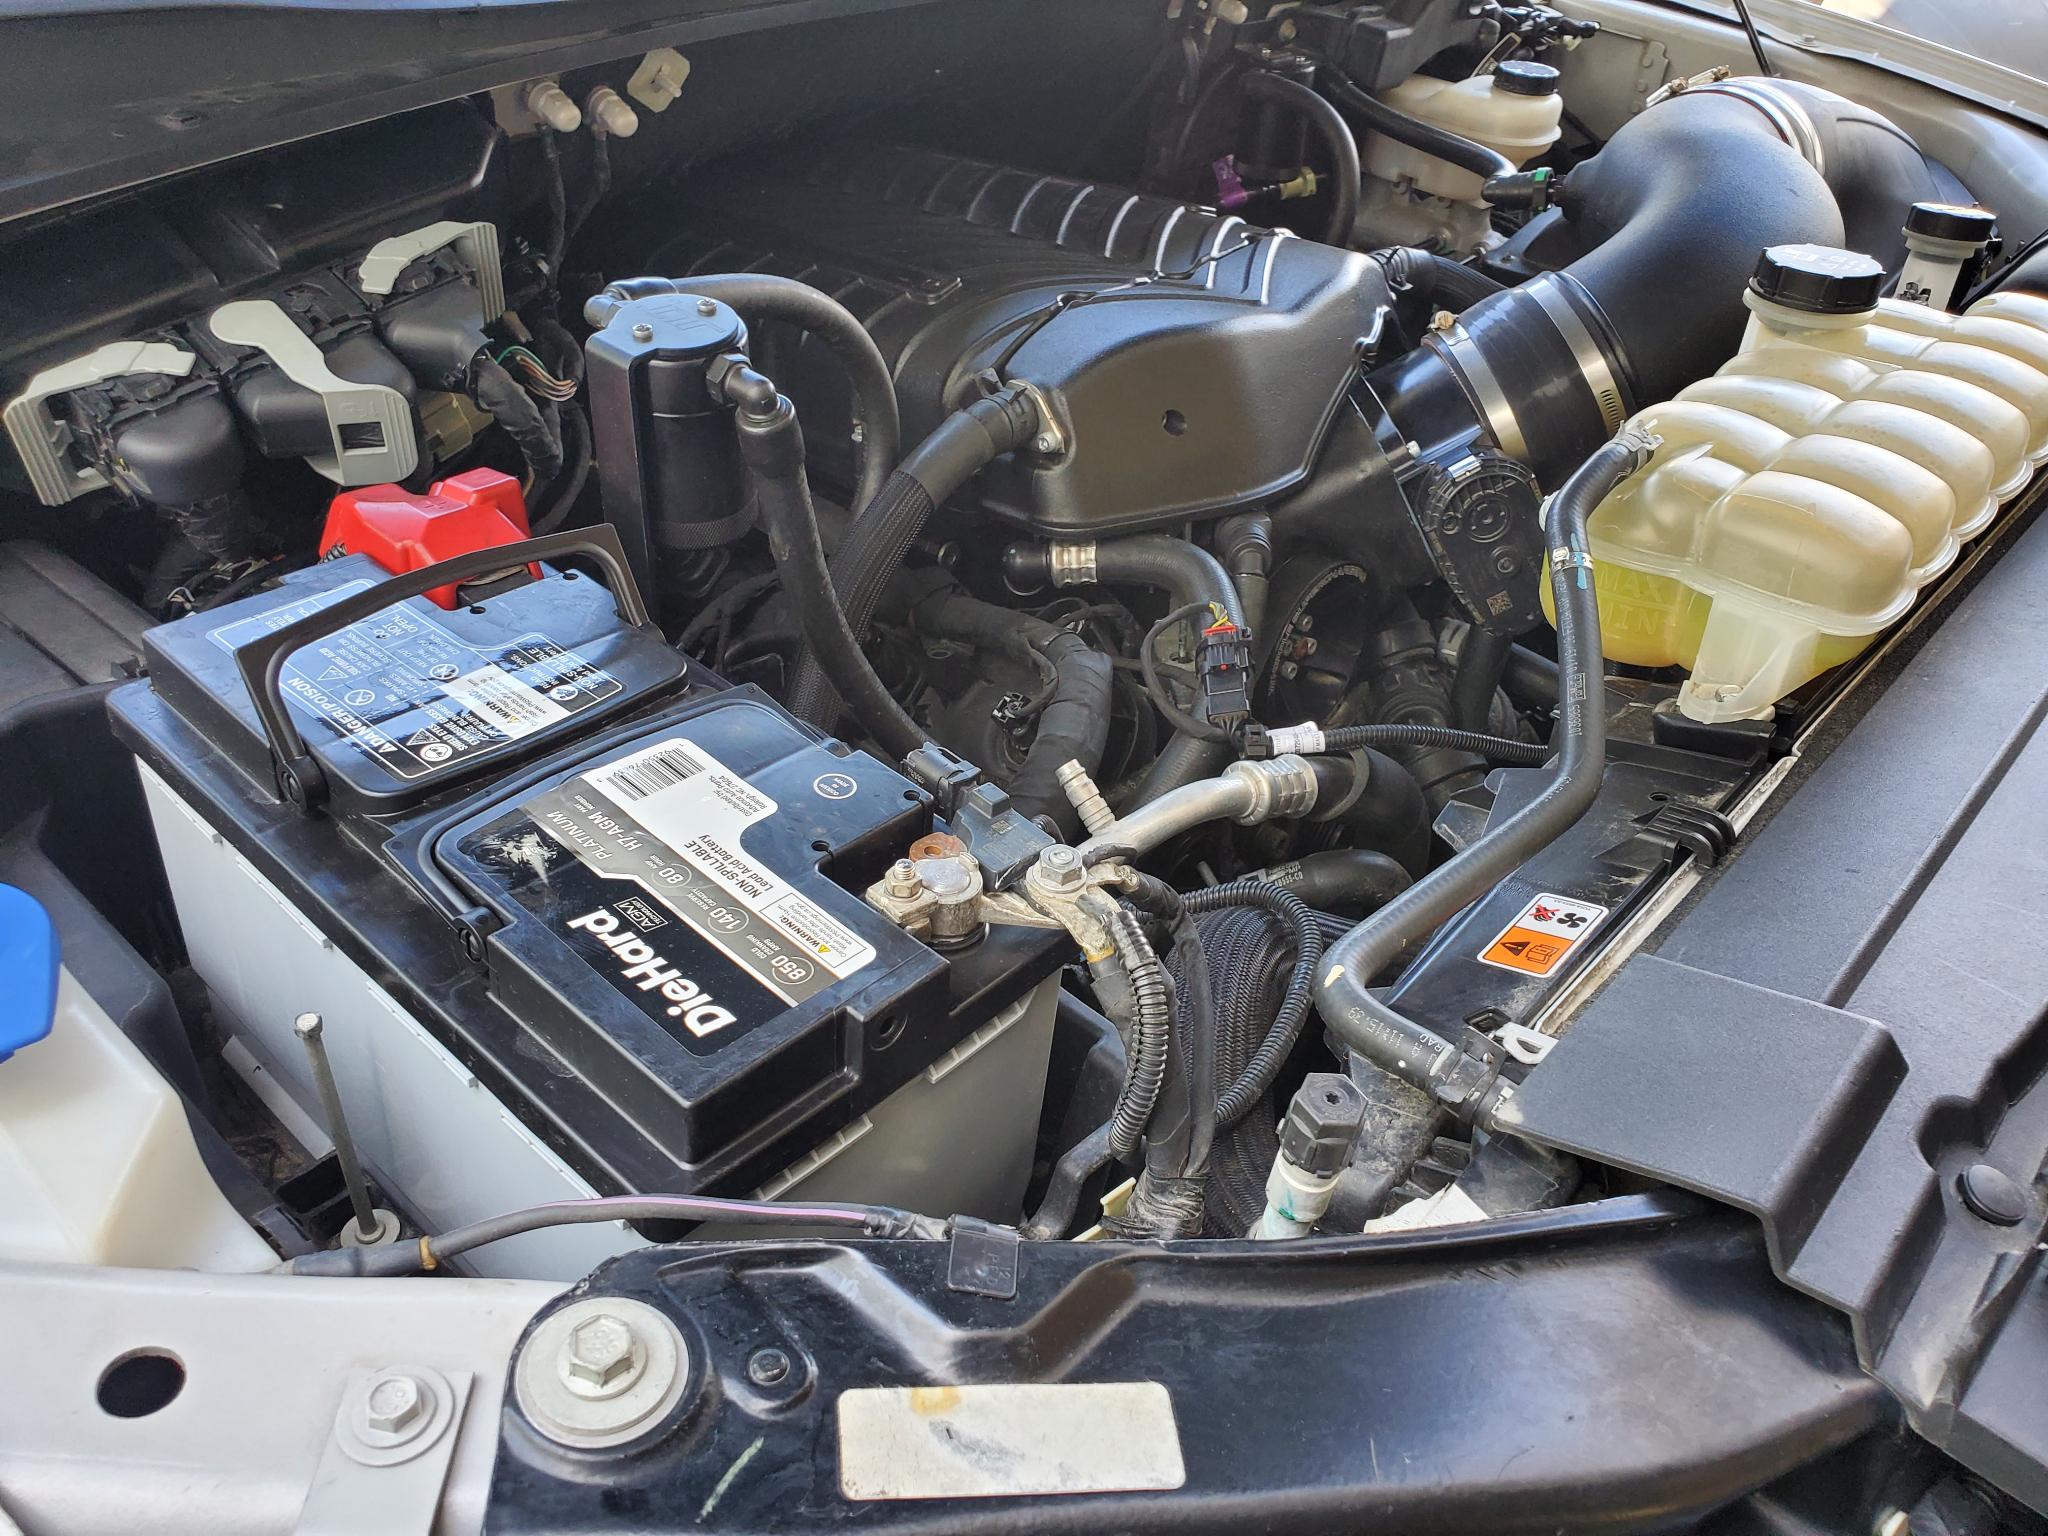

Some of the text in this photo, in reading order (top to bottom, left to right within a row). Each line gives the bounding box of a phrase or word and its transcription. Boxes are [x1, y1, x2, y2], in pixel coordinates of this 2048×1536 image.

[1600, 564, 1663, 602] MAX
[382, 622, 405, 634] NOT
[508, 653, 559, 684] INSTRUCTIONS.
[528, 647, 598, 688] NON-SPILLABLE
[286, 677, 387, 745] DANGER/POISON
[425, 709, 449, 722] GASES
[441, 734, 468, 750] SHIELD
[443, 722, 480, 744] EXPLOSIVE
[464, 724, 489, 739] CAUSE
[734, 795, 759, 812] Advance
[546, 809, 613, 859] PLATINUM
[586, 811, 643, 850] H7-AGM
[649, 853, 665, 866] HOUR
[683, 839, 762, 898] NON-SPILLABLE
[696, 832, 774, 891] Lead Acid Battery
[656, 866, 684, 884] 80
[685, 892, 710, 909] RESERVE
[691, 887, 717, 906] CAPACITY
[618, 902, 655, 928] AGM
[707, 906, 743, 930] 140
[777, 915, 821, 946] WARNING:
[745, 933, 775, 954] CRANKING
[750, 946, 767, 959] COLD
[763, 938, 781, 950] AMPS
[565, 905, 738, 1037] DieHard
[769, 954, 807, 980] 850
[1420, 1033, 1444, 1052] RAD
